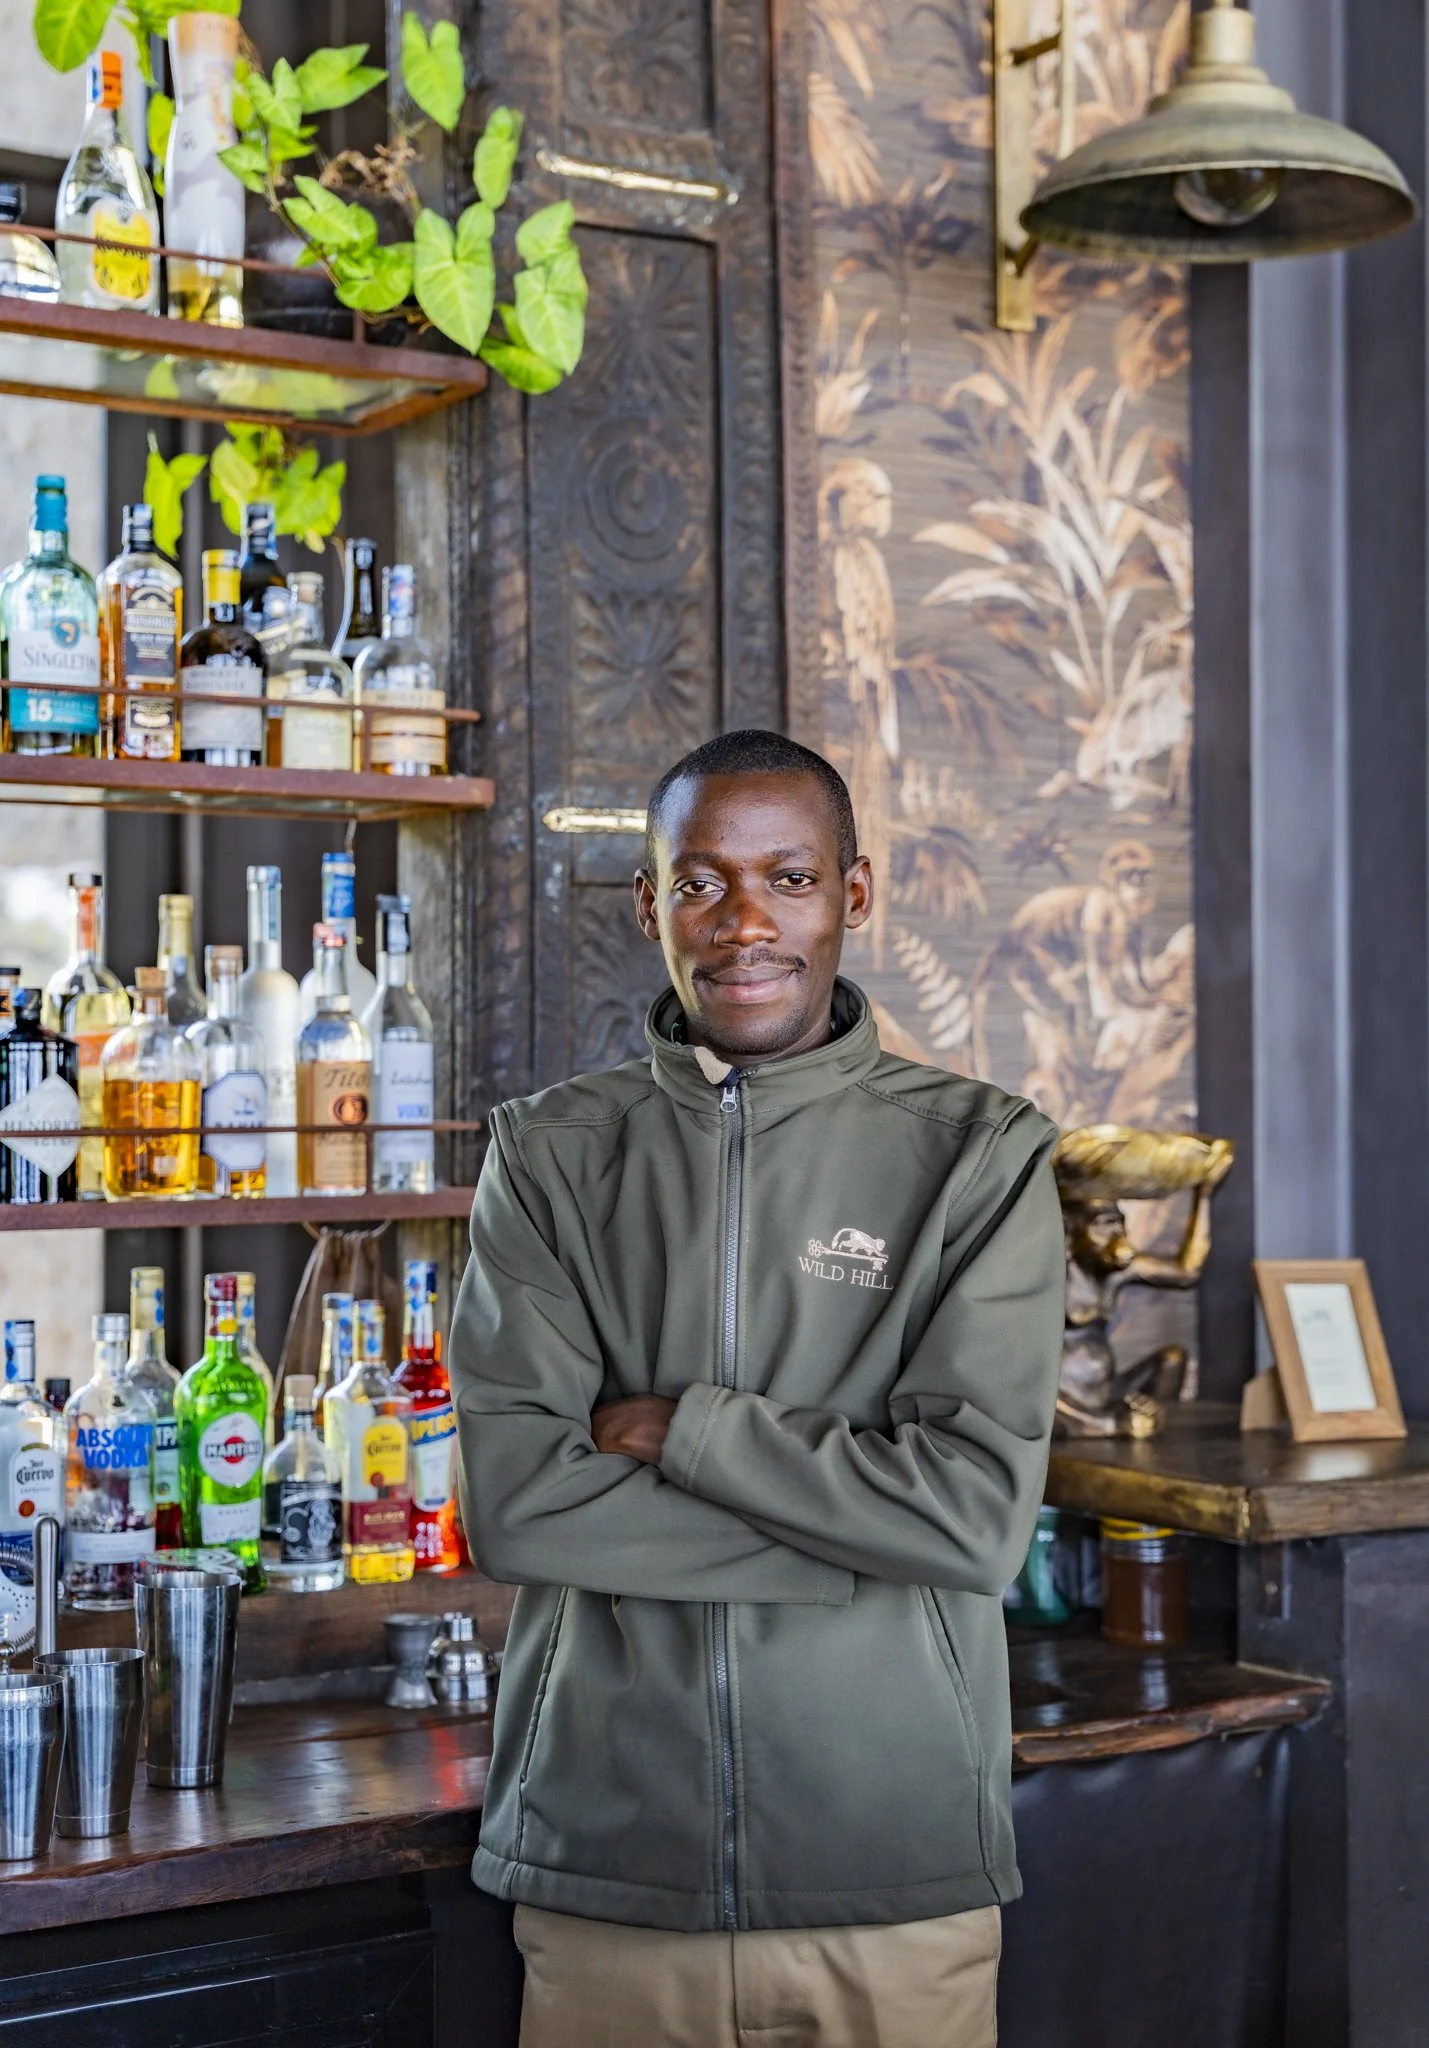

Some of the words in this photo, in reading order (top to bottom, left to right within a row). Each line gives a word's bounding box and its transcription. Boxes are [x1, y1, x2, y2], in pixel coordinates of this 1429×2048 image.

[799, 1256, 845, 1281] WILD
[850, 1268, 894, 1290] HILL
[83, 1446, 149, 1469] VODKA
[205, 1440, 262, 1459] MARTINI
[16, 1466, 55, 1485] Cuervo
